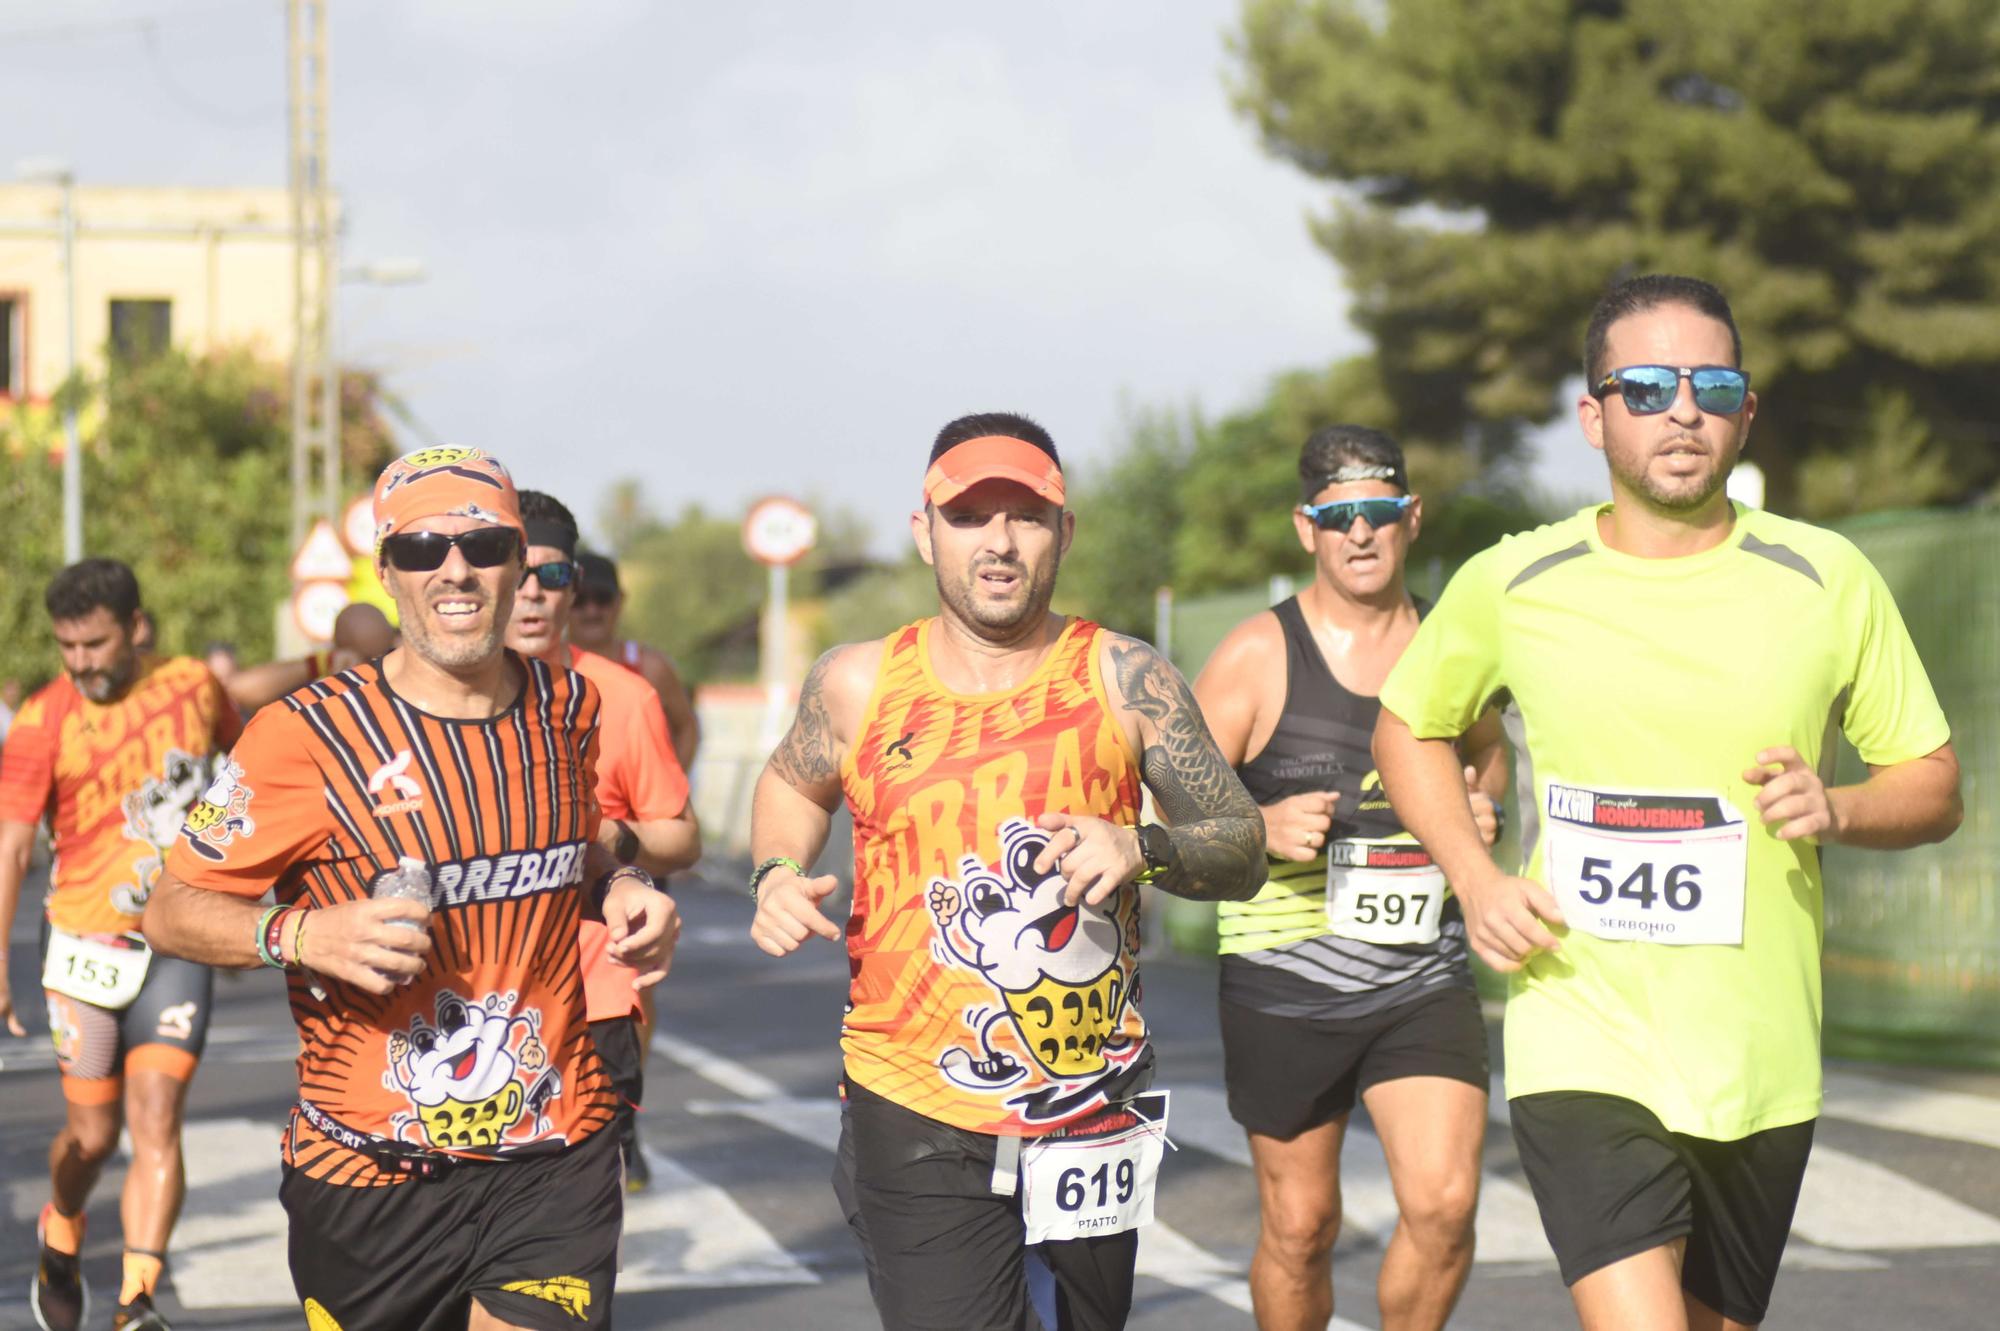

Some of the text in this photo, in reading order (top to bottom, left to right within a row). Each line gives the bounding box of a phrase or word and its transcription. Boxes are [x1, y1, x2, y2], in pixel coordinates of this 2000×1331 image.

[1595, 806, 1705, 829] NONDUERMAS
[1579, 857, 1702, 912] 546
[1354, 893, 1430, 926] 597
[65, 954, 120, 990] 153
[1055, 1158, 1134, 1212] 619
